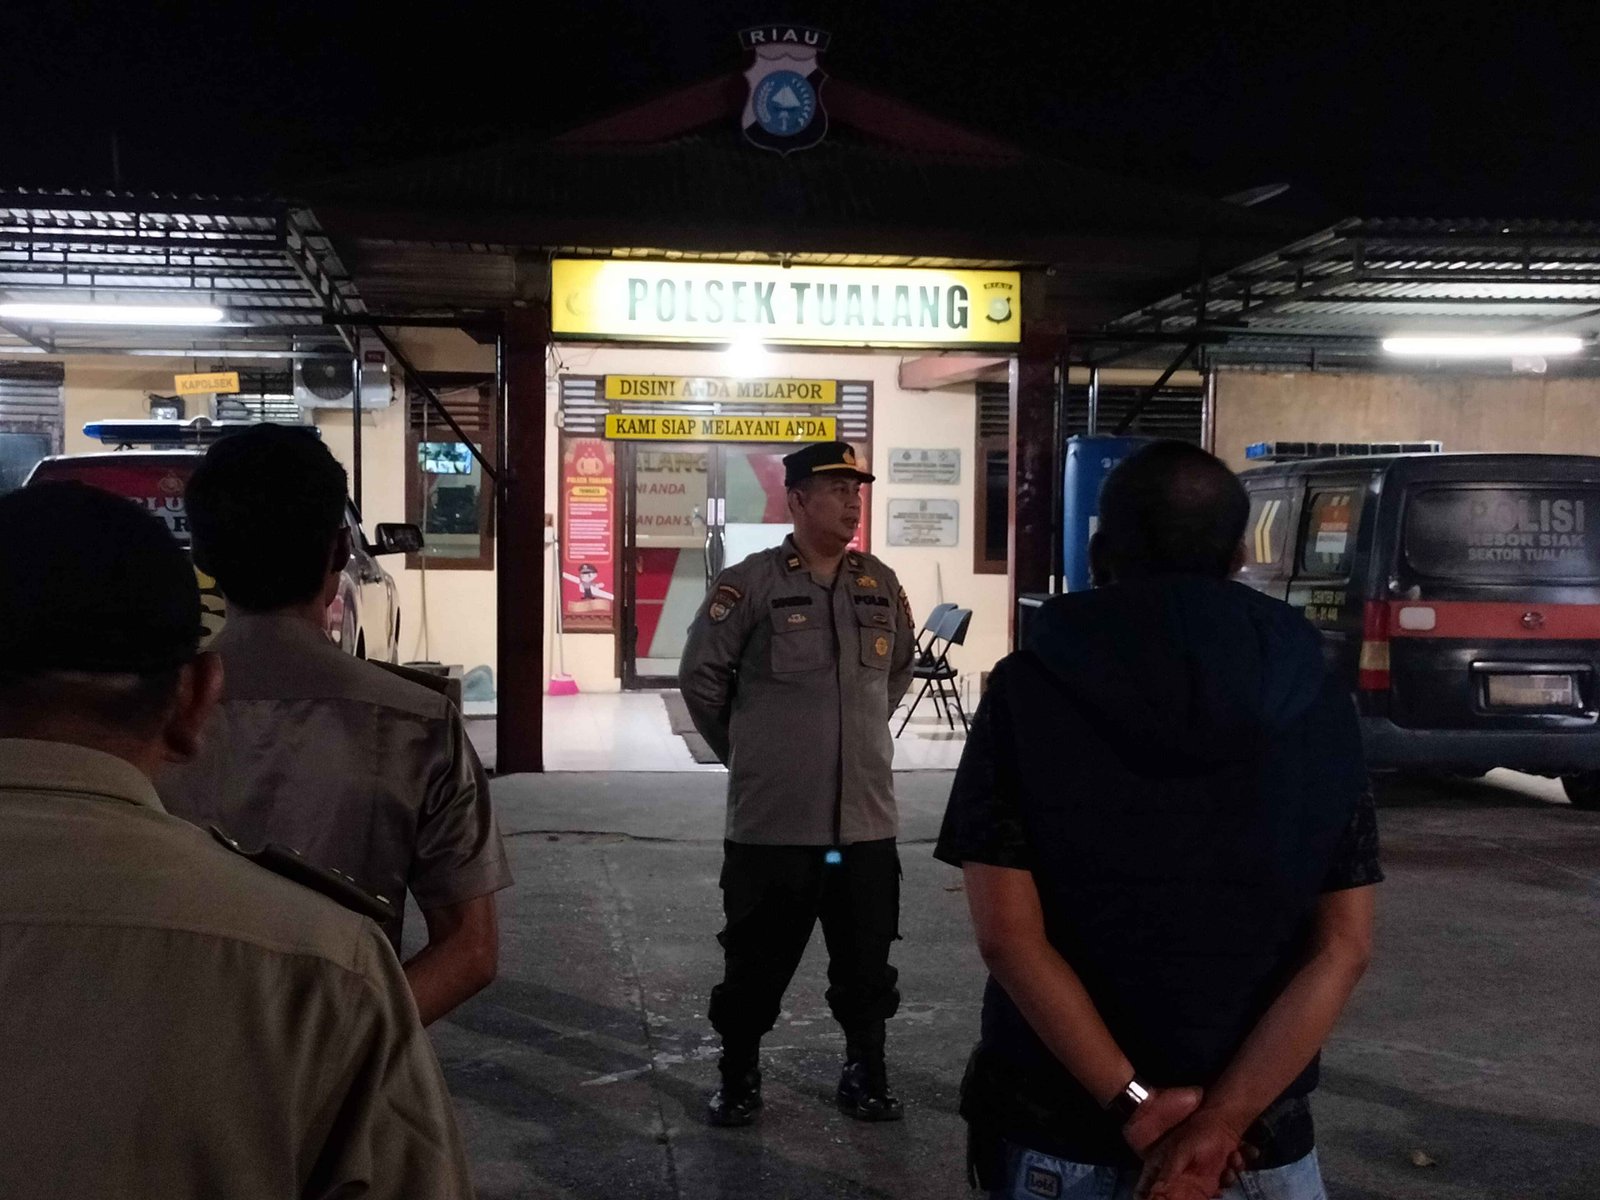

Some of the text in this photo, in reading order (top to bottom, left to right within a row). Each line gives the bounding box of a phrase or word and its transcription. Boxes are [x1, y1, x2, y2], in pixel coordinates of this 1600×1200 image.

[750, 28, 819, 45] RIAU
[628, 278, 968, 329] POLSEK TUALANG
[181, 379, 233, 389] KAPOLSEK
[620, 379, 823, 399] DISINI ANDA MELAPOR
[616, 418, 827, 437] KAMI SIAP MELAYANI ANDA
[649, 484, 686, 494] ANDA
[655, 515, 682, 526] DAN
[1470, 499, 1585, 532] POLISI
[1539, 534, 1585, 546] SIAK
[1468, 548, 1521, 561] SEKTOR
